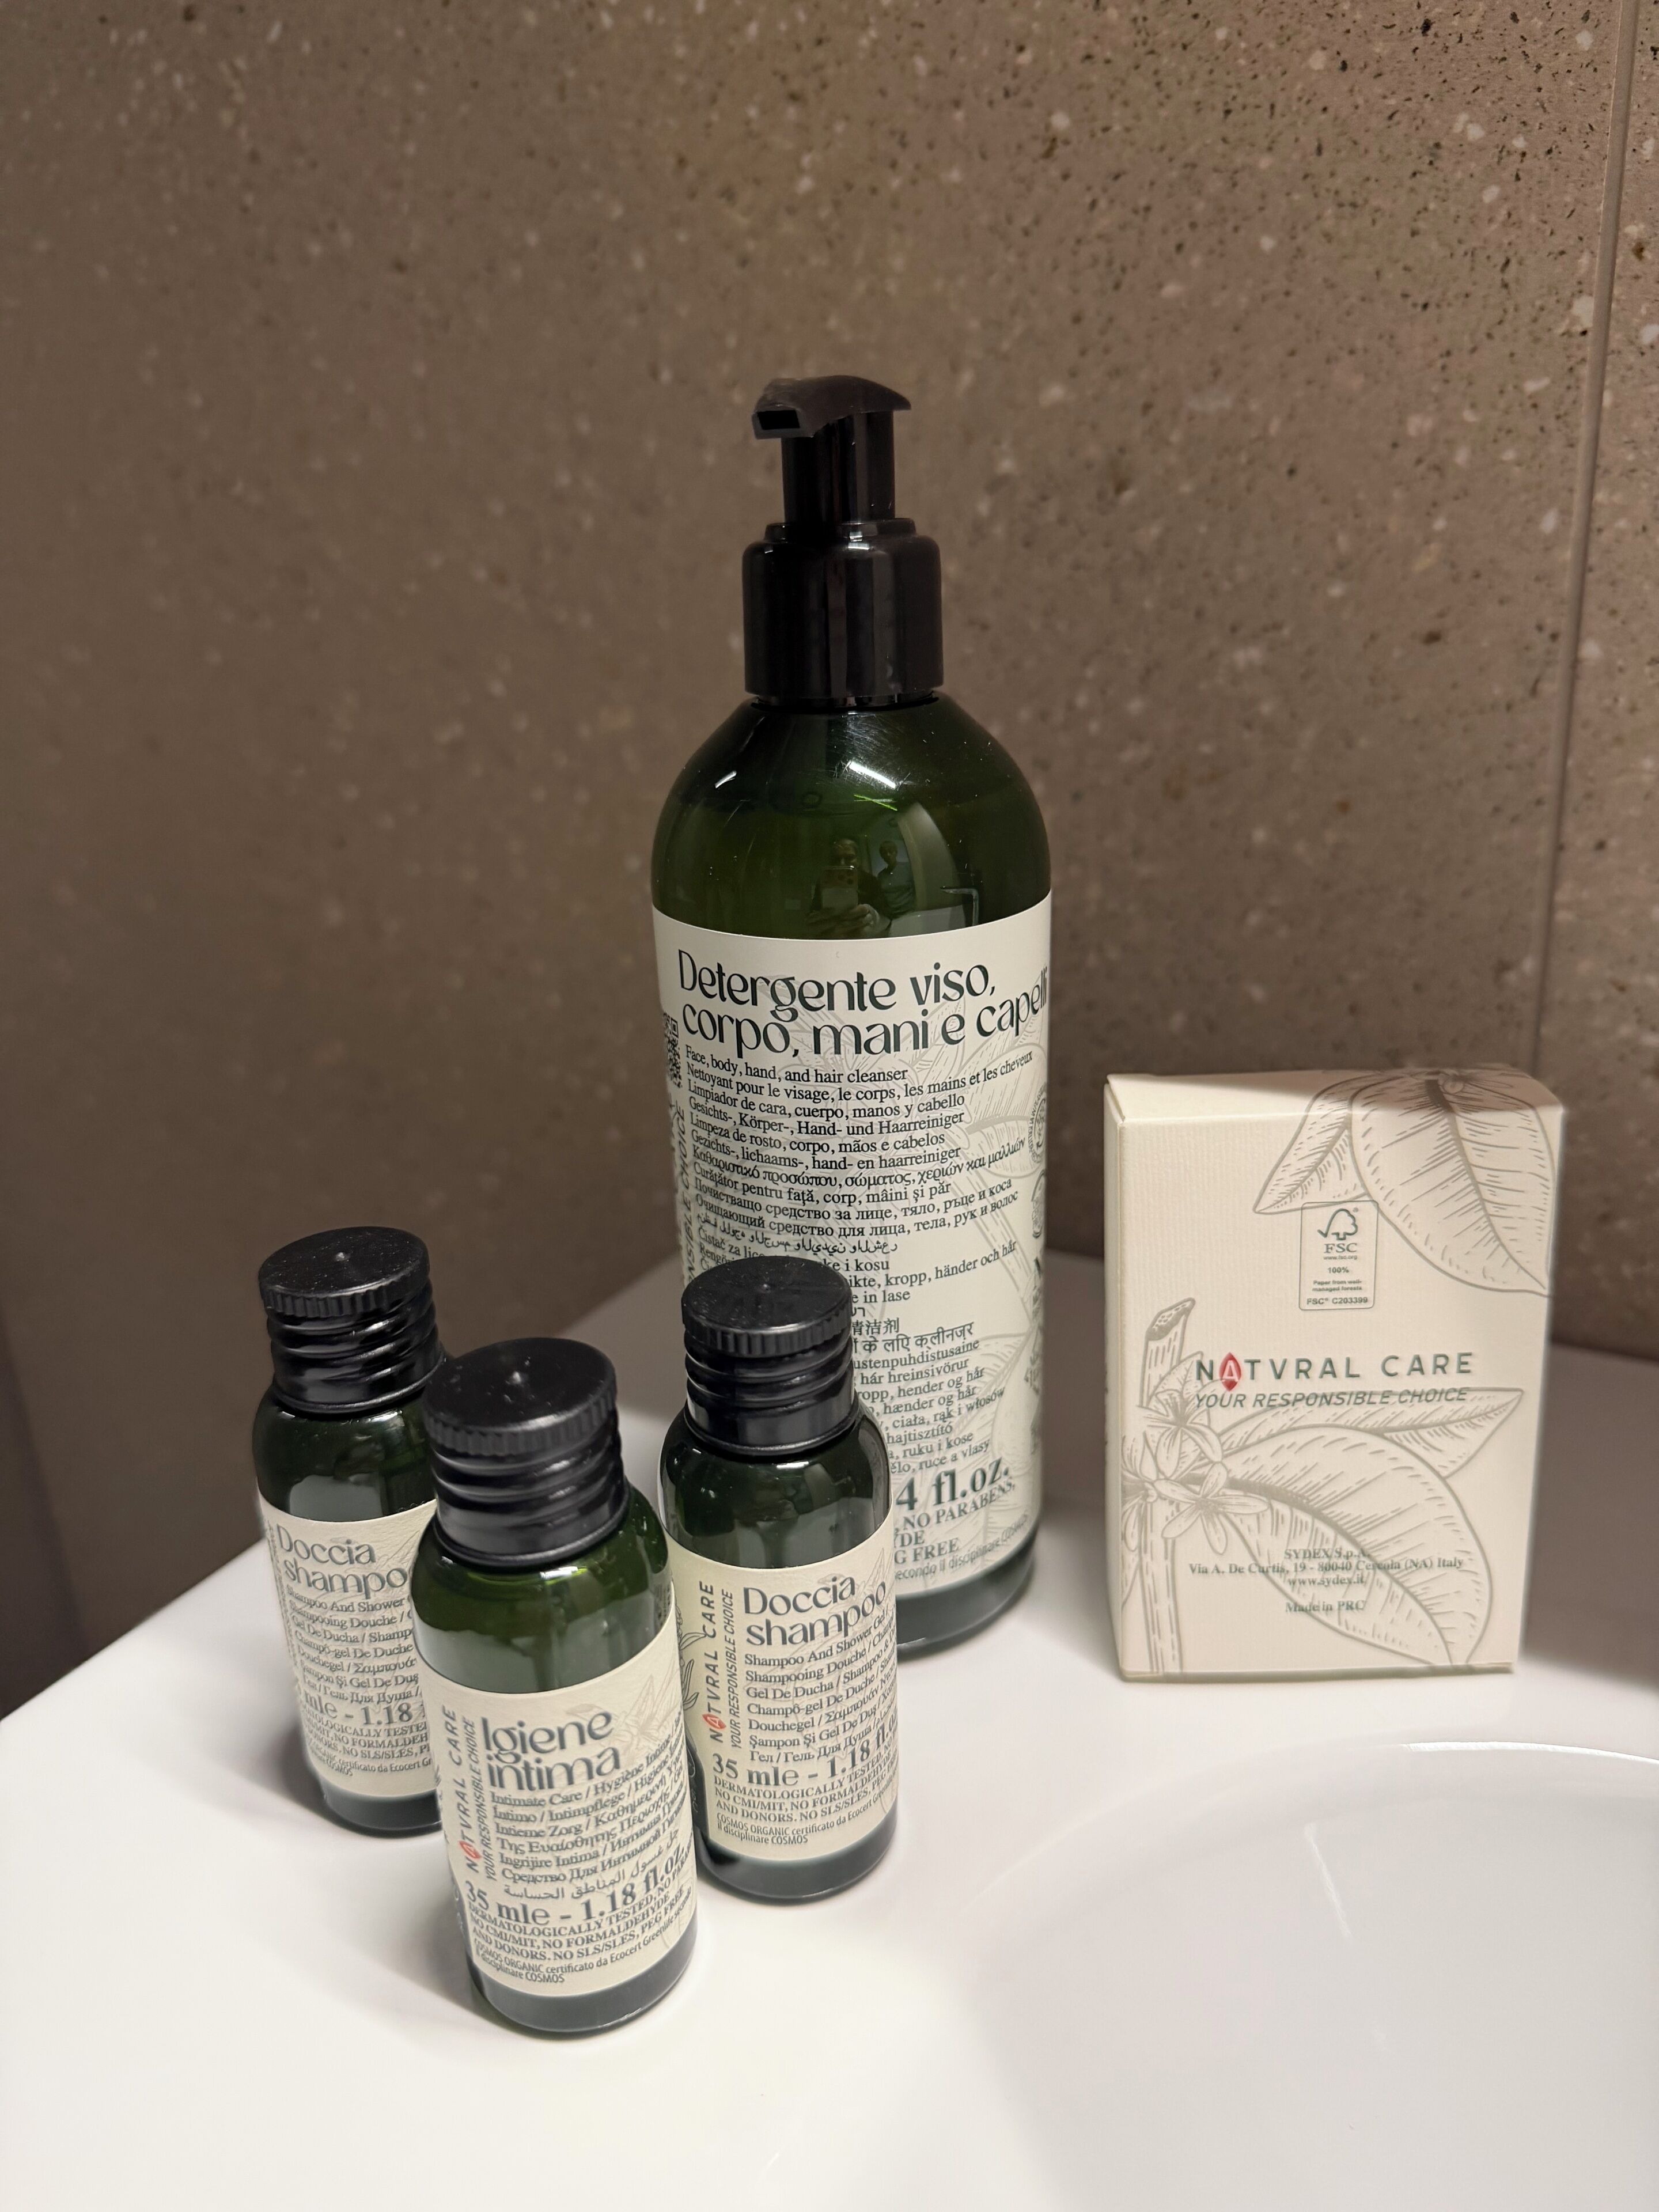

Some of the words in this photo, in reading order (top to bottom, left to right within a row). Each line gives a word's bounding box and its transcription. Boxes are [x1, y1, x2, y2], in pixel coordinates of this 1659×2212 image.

[679, 949, 896, 1022] Detergente
[910, 962, 995, 1006] viso,
[683, 1003, 800, 1059] corpo,
[813, 1008, 929, 1055] mani
[941, 1013, 966, 1046] e
[976, 965, 1047, 1037] capelli
[685, 1044, 709, 1068] Face,
[710, 1054, 742, 1077] body,
[744, 1062, 782, 1082] hand,
[784, 1069, 810, 1083] and
[814, 1069, 844, 1084] hair
[847, 1069, 908, 1084] cleanser
[686, 1061, 734, 1090] Nettoyant
[736, 1081, 764, 1096] pour
[768, 1083, 781, 1097] le
[783, 1085, 835, 1104] visage,
[838, 1087, 852, 1101] le
[855, 1089, 901, 1103] corps,
[904, 1083, 924, 1097] les
[927, 1077, 966, 1094] mains
[969, 1072, 981, 1085] et
[982, 1067, 998, 1082] les
[1000, 1051, 1033, 1075] cheveux
[688, 1078, 740, 1107] Limpiador
[741, 1097, 756, 1111] de
[759, 1103, 791, 1118] cara,
[794, 1107, 849, 1122] cuerpo,
[853, 1105, 900, 1118] manos
[904, 1104, 914, 1118] y
[917, 1093, 965, 1113] cabello
[689, 1096, 737, 1126] Gesichts-,
[738, 1112, 794, 1135] Körper-,
[797, 1121, 842, 1135] Hand-
[847, 1122, 874, 1135] und
[878, 1112, 964, 1134] Haarreiniger
[690, 1112, 730, 1139] Limpeza
[733, 1128, 747, 1142] de
[749, 1135, 786, 1151] rosto,
[790, 1140, 835, 1155] corpo,
[838, 1139, 877, 1153] mãos
[881, 1141, 889, 1152] e
[893, 1133, 945, 1150] cabelos
[691, 1129, 740, 1159] Gezichts-,
[741, 1146, 809, 1170] lichaams-,
[812, 1156, 853, 1170] hand-
[857, 1159, 874, 1170] en
[878, 1147, 961, 1169] haarreiniger
[845, 1172, 915, 1190] σώματος,
[917, 1161, 964, 1185] χεριών
[695, 1177, 762, 1213] Почистващо
[766, 1204, 831, 1221] средство
[835, 1211, 851, 1220] за
[855, 1209, 897, 1221] лице,
[900, 1203, 940, 1217] тяло,
[943, 1194, 975, 1213] ръце
[978, 1191, 986, 1201] и
[988, 1179, 1012, 1197] коса
[696, 1194, 766, 1229] Очищающий
[769, 1221, 834, 1237] средство
[838, 1226, 865, 1238] для
[869, 1224, 911, 1236] лица,
[914, 1217, 951, 1232] тела,
[953, 1209, 977, 1228] рук
[980, 1206, 988, 1216] и
[991, 1190, 1018, 1213] волос
[741, 1184, 783, 1199] pentru
[823, 1194, 862, 1207] corp,
[866, 1188, 908, 1203] mâini
[884, 1272, 931, 1287] kropp,
[935, 1259, 978, 1279] händer
[980, 1249, 1000, 1266] och
[1002, 1239, 1017, 1257] hår
[1324, 1243, 1358, 1253] FSC
[1195, 1356, 1361, 1383] NATVRAL
[1381, 1351, 1473, 1377] CARE
[1195, 1393, 1246, 1409] YOUR
[1253, 1389, 1393, 1408] RESPONSIBLE
[1397, 1387, 1470, 1404] CHOICE
[903, 1512, 931, 1528] NO
[276, 1523, 376, 1565] Doccia
[912, 1537, 959, 1562] FREE
[1284, 1548, 1332, 1559] SYDEX
[283, 1558, 411, 1599] shampo
[1189, 1563, 1208, 1574] Via
[1211, 1563, 1225, 1574] A.
[1229, 1563, 1245, 1574] De
[1248, 1562, 1290, 1575] Curtis,
[1293, 1562, 1306, 1573] 19
[1317, 1560, 1352, 1572] 80040
[1405, 1558, 1433, 1570] (NA)
[1437, 1557, 1463, 1570] Italy
[1287, 1575, 1365, 1588] www.sydex.it
[331, 1601, 355, 1612] And
[358, 1597, 406, 1613] Shower
[699, 1581, 717, 1638] CARE
[721, 1589, 735, 1635] CHOICE
[743, 1576, 856, 1616] Doccia
[746, 1581, 887, 1646] shampoo
[1285, 1601, 1320, 1612] Made
[1322, 1601, 1333, 1612] in
[1337, 1599, 1365, 1611] PRC
[349, 1615, 397, 1628] Douche
[745, 1653, 804, 1669] Shampoo
[807, 1646, 834, 1662] And
[836, 1625, 872, 1657] Shower
[745, 1668, 824, 1684] Shampooing
[827, 1647, 866, 1674] Douche
[724, 1635, 740, 1718] RESPONSIBLE
[361, 1702, 414, 1725] 1.18
[704, 1650, 724, 1743] NATVRAL
[442, 1705, 461, 1766] CARE
[480, 1710, 613, 1764] Igiene
[730, 1719, 742, 1749] YOUR
[486, 1746, 621, 1791] intima
[713, 1753, 738, 1779] 35
[827, 1740, 870, 1778] 1.18
[714, 1776, 845, 1798] DERMATOLOGICALLY
[733, 1794, 788, 1811] CMI/MIT,
[717, 1813, 748, 1831] COSMOS
[750, 1823, 790, 1835] ORGANIC
[791, 1820, 835, 1835] certificato
[848, 1801, 872, 1821] Ecocert
[465, 1881, 490, 1910] 35
[581, 1882, 637, 1921] 1.18
[469, 1903, 603, 1936] DERMATOLOGICALLY
[546, 1960, 594, 1975] certificato
[610, 1946, 642, 1965] Ecocert
